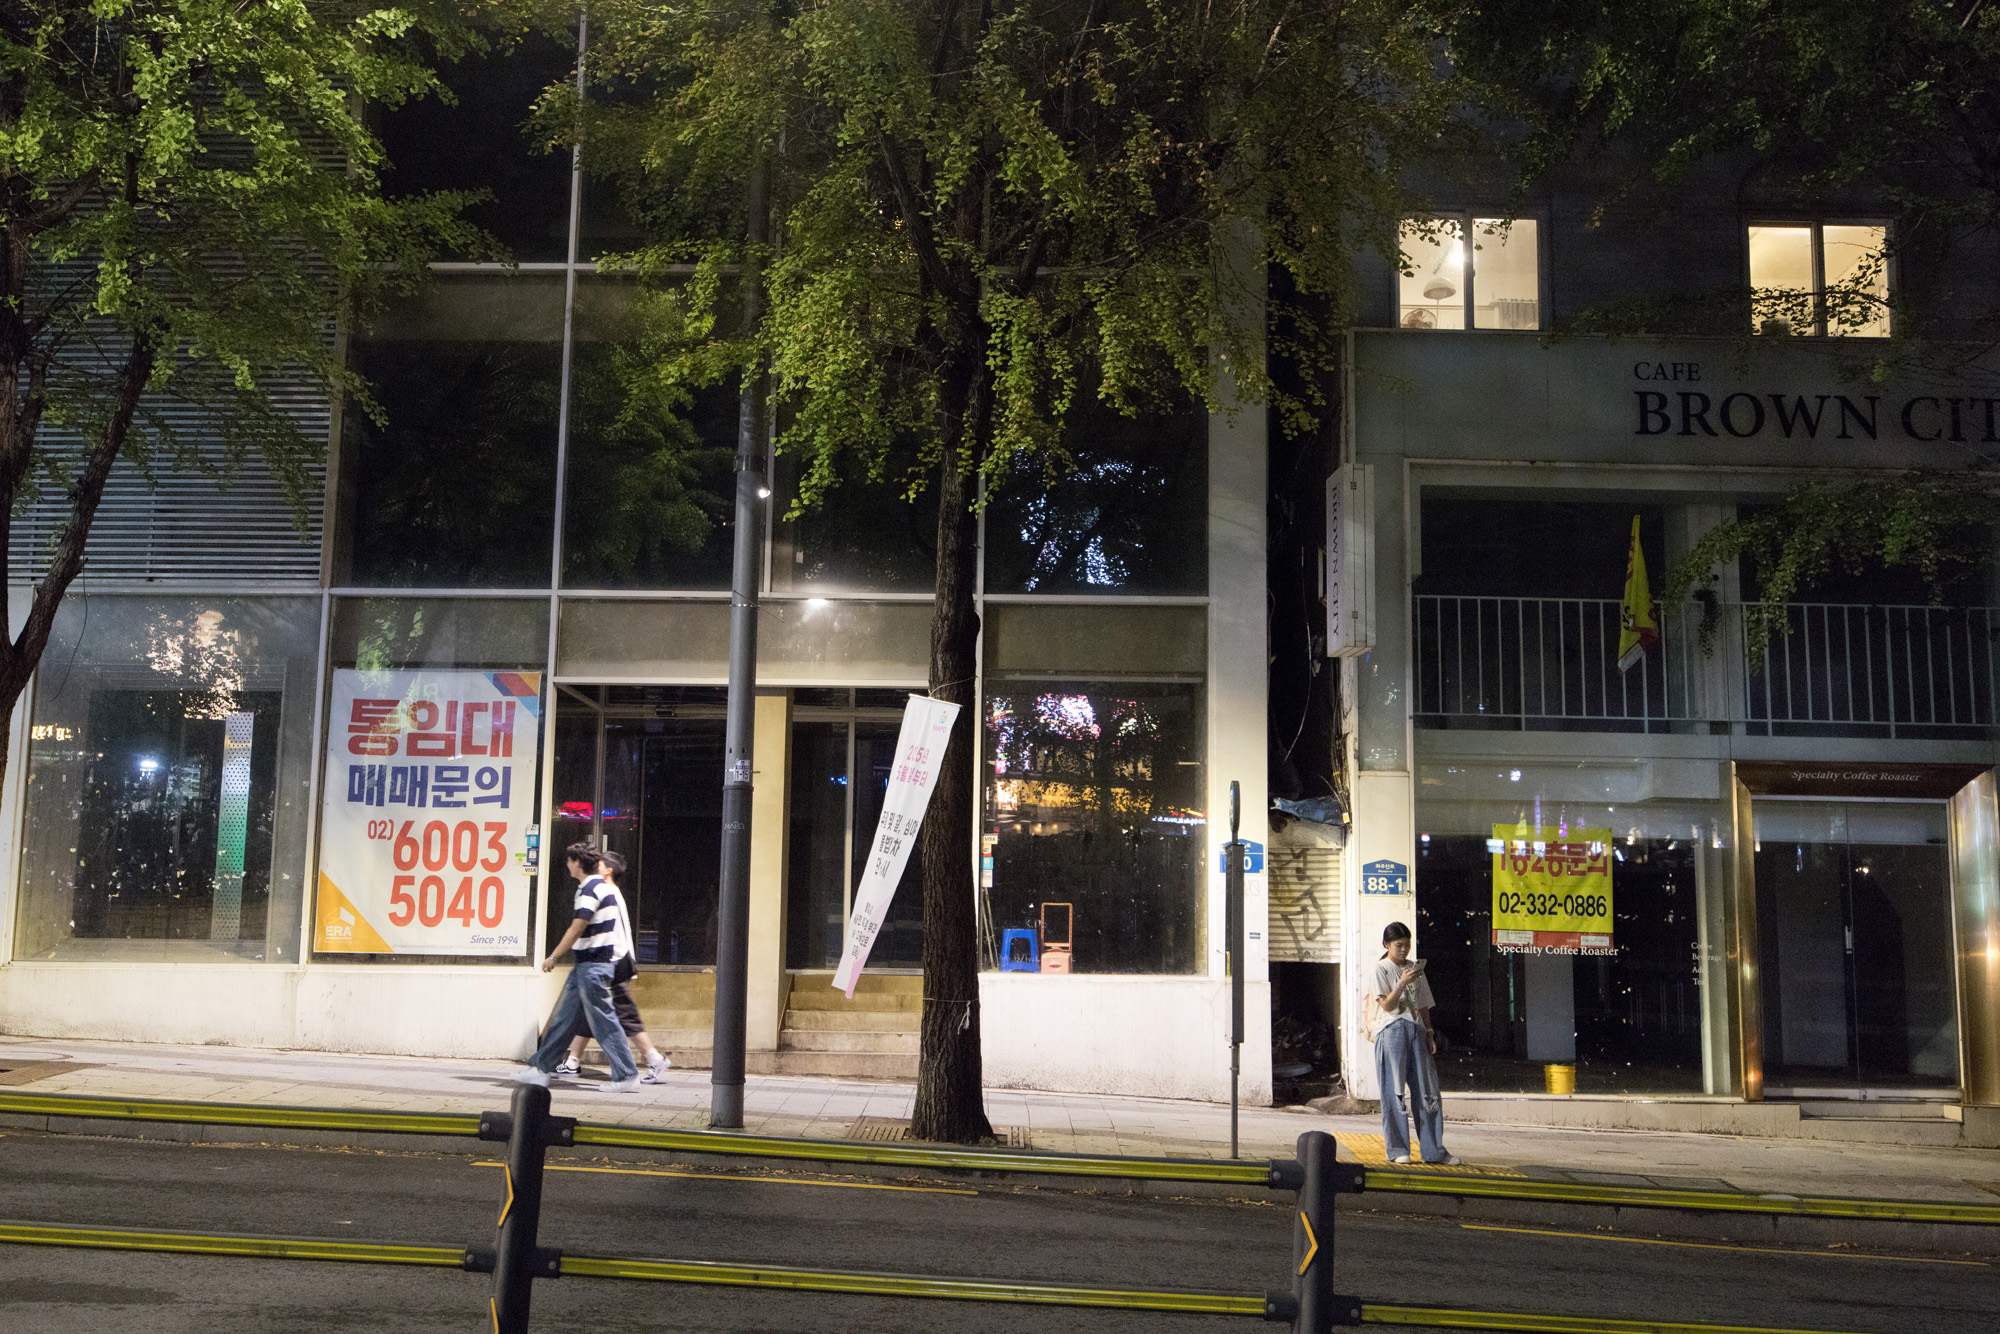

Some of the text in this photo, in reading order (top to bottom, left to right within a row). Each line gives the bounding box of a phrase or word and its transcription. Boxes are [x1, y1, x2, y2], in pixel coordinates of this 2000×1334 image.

[1633, 361, 1701, 382] CAFE
[1633, 390, 1881, 441] BROWN
[347, 698, 517, 758] 통임대
[1791, 771, 1921, 782] Specialty Coffee Roaster
[347, 764, 512, 809] 매매문의
[367, 819, 508, 873] 02) 6003
[1367, 876, 1403, 892] 88-1
[388, 875, 505, 929] 5040
[1499, 891, 1607, 918] 02-332-0886
[325, 926, 352, 937] ERA
[470, 934, 519, 945] Since 1994
[1497, 943, 1619, 957] Specialty Coffee Roaster
[1690, 941, 1713, 950] Coee
[1692, 953, 1722, 962] Bevrage
